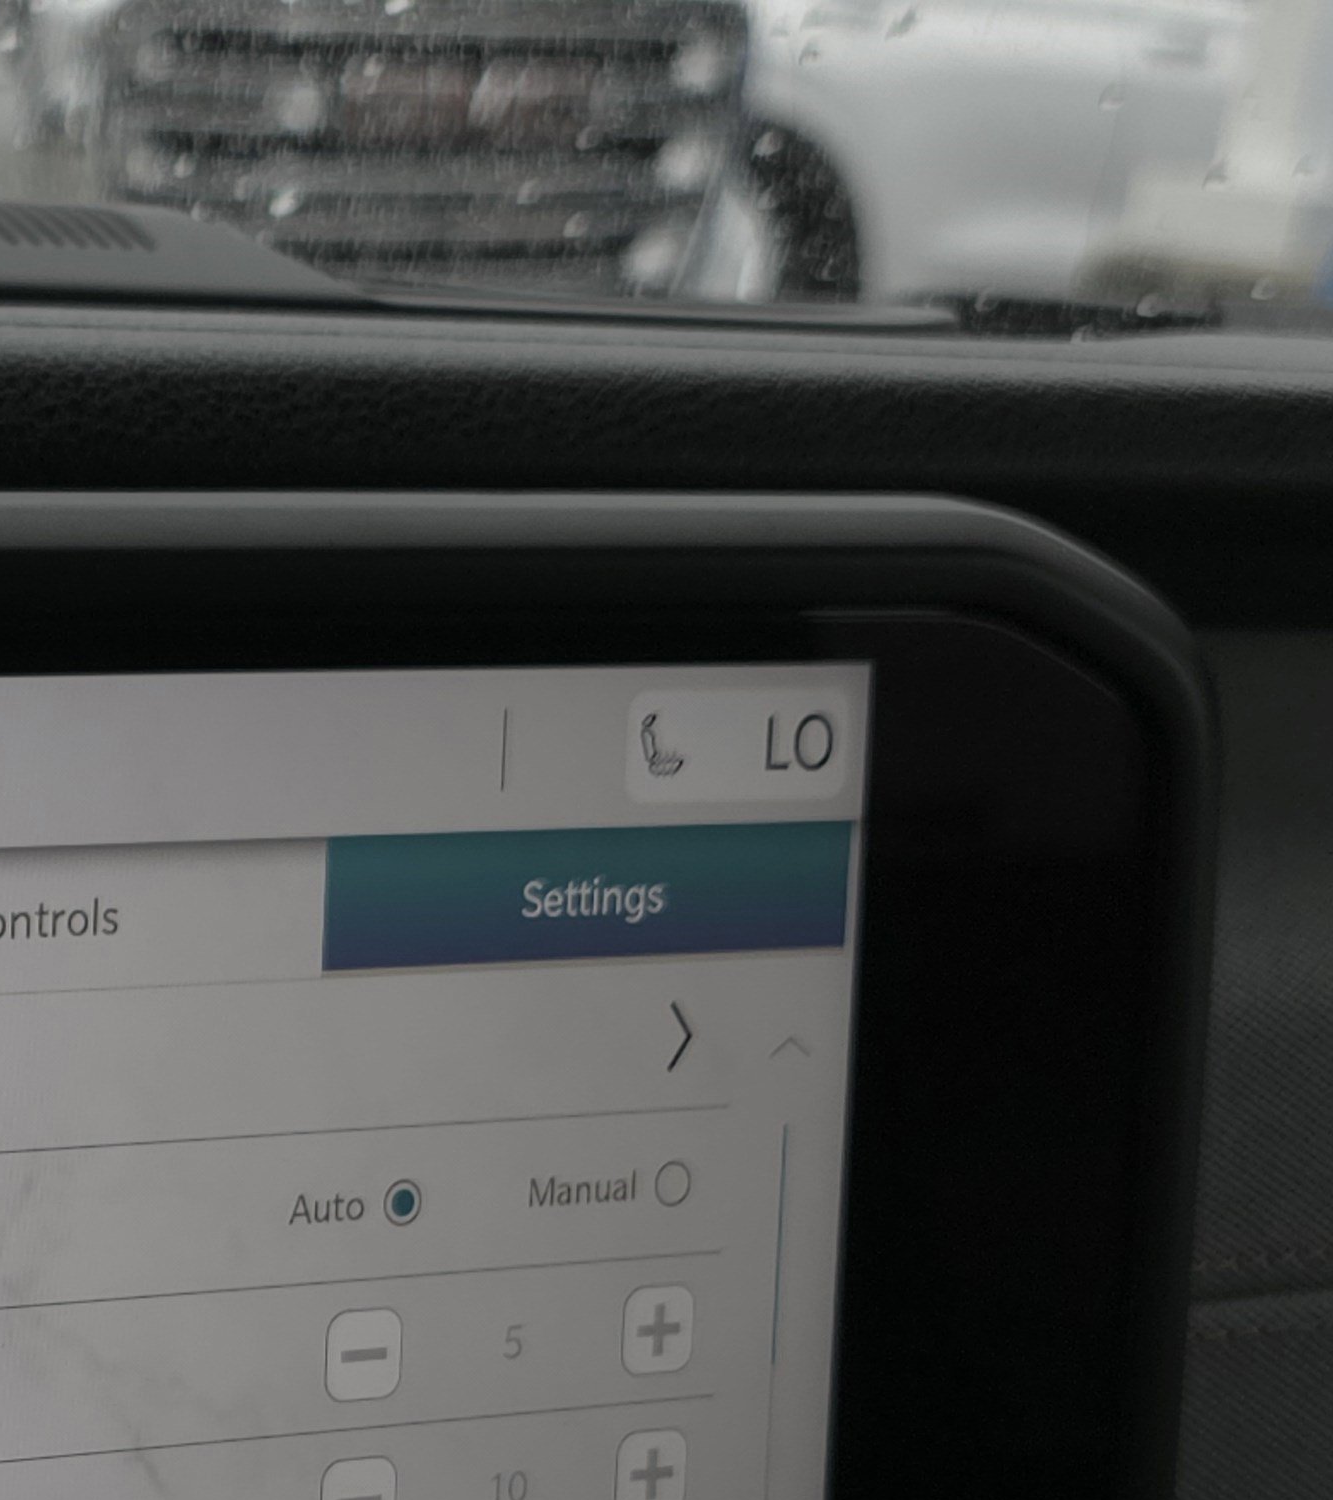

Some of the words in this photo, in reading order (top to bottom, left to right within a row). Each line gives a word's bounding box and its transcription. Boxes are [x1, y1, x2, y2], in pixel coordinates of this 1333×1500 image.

[765, 713, 834, 772] LO
[521, 876, 664, 923] Settings
[528, 1169, 637, 1207] Manual
[289, 1193, 365, 1225] Auto
[503, 1324, 523, 1360] 5
